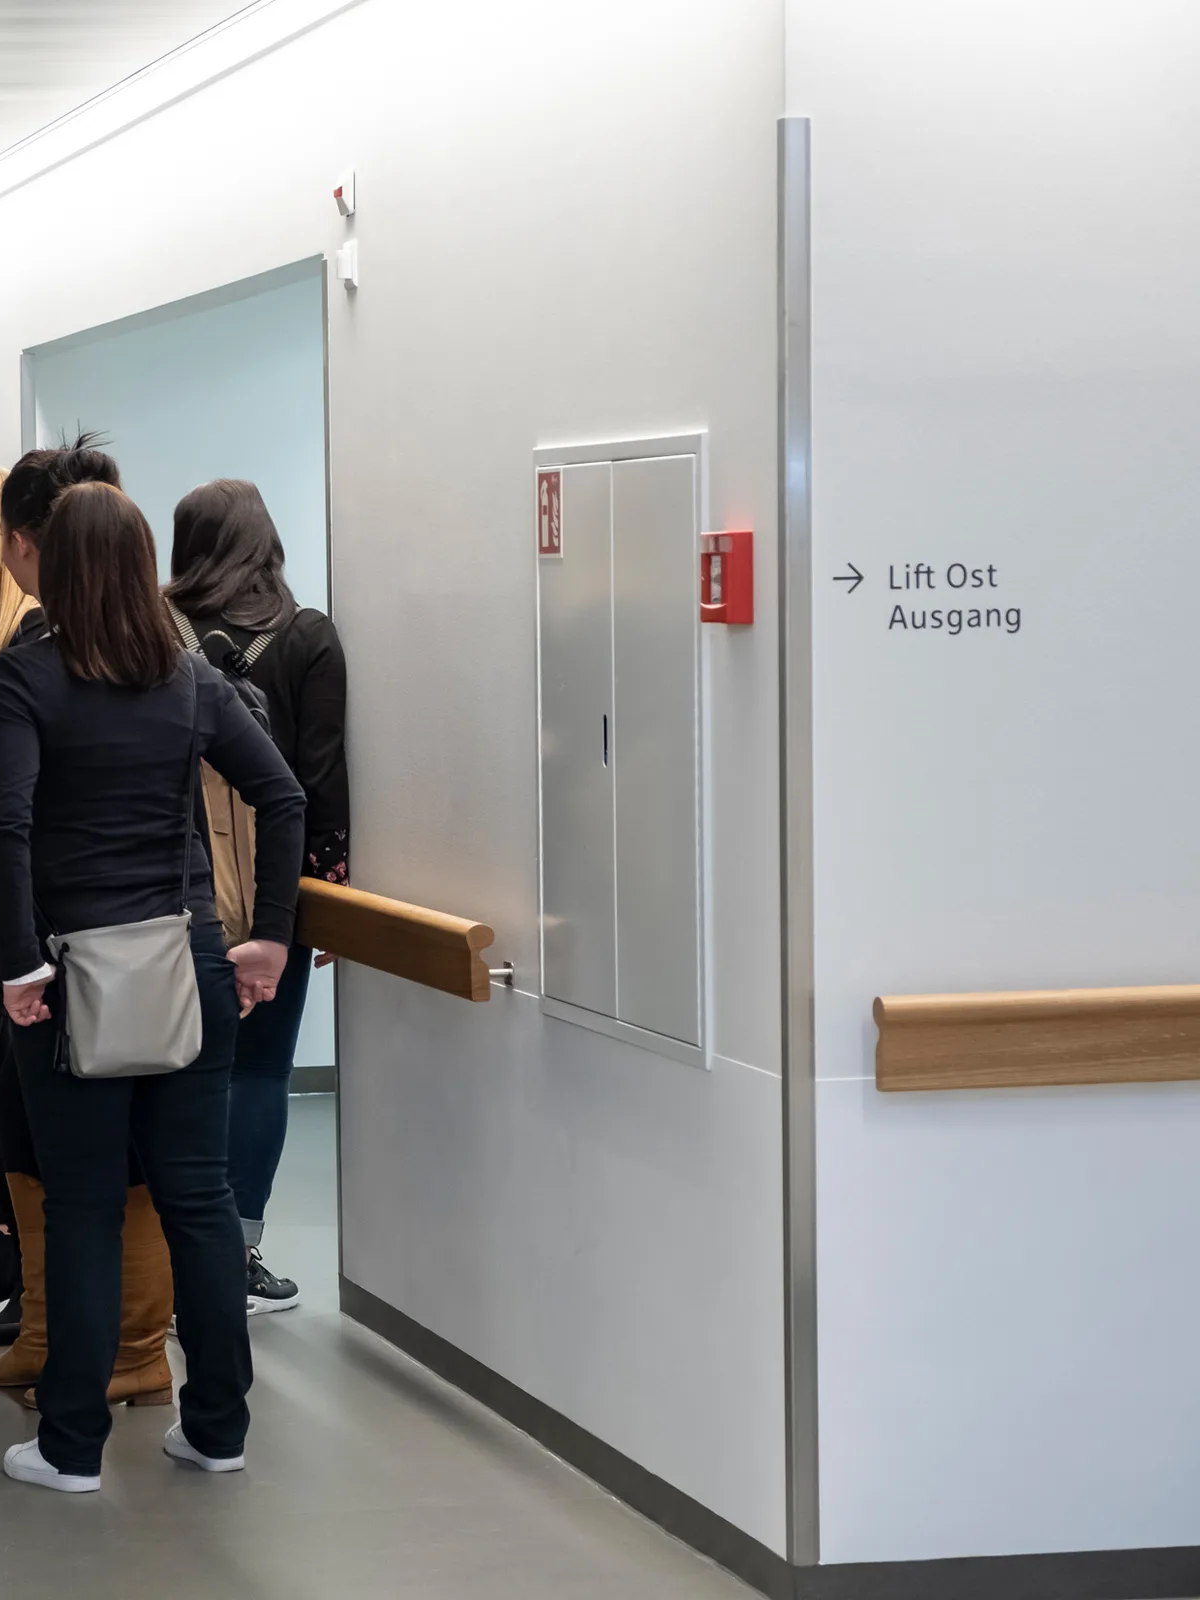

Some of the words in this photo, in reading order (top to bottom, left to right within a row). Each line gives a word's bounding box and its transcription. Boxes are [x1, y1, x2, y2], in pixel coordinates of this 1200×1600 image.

[888, 562, 936, 590] Lift
[946, 562, 999, 589] Ost
[888, 604, 1022, 636] Ausgang
